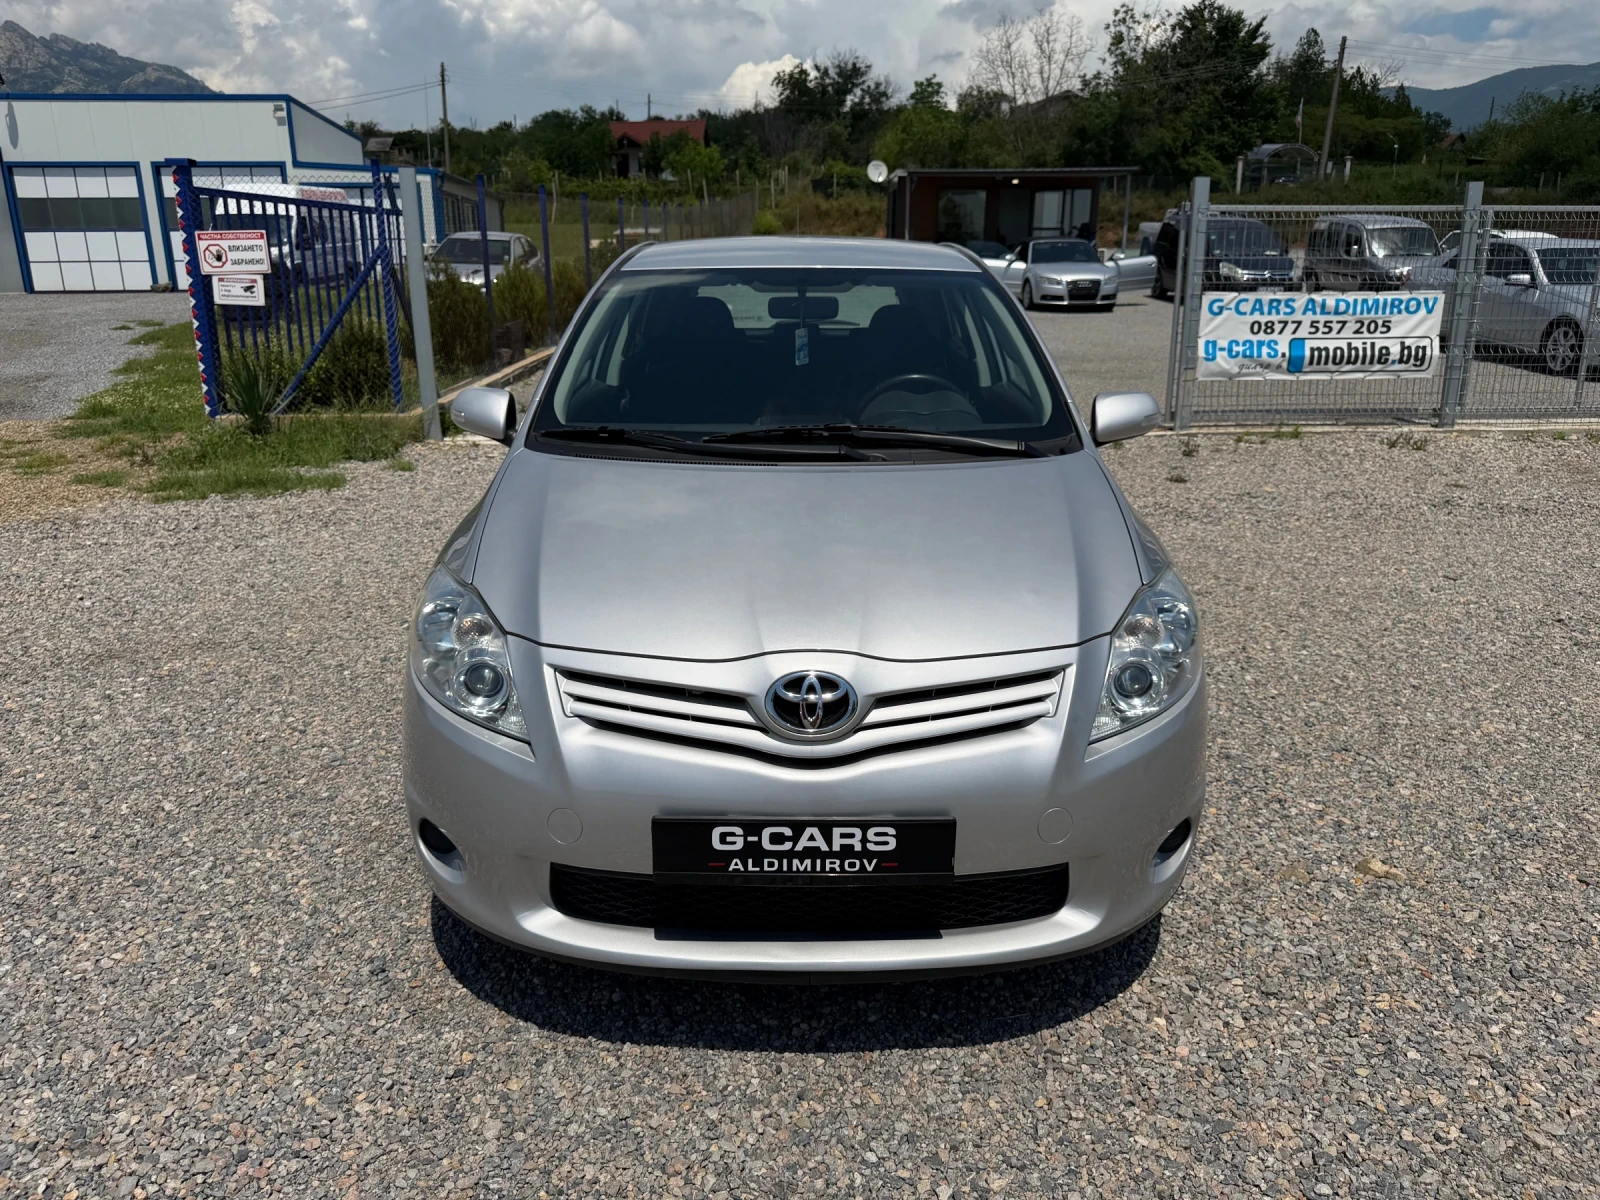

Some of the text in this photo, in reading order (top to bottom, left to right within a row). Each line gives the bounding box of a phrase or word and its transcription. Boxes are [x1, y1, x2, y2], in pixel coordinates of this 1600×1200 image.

[228, 244, 263, 252] ВЛИЗАНЕТО
[230, 258, 265, 266] ЗАБРАНЕНО!
[1207, 297, 1439, 316] G-CARS ALDIMIROV
[1250, 320, 1392, 335] 0877 557 205
[1203, 339, 1428, 367] g-cars. mobile.bg
[711, 826, 897, 851] G-CARS
[727, 858, 878, 872] ALDIMIROV
